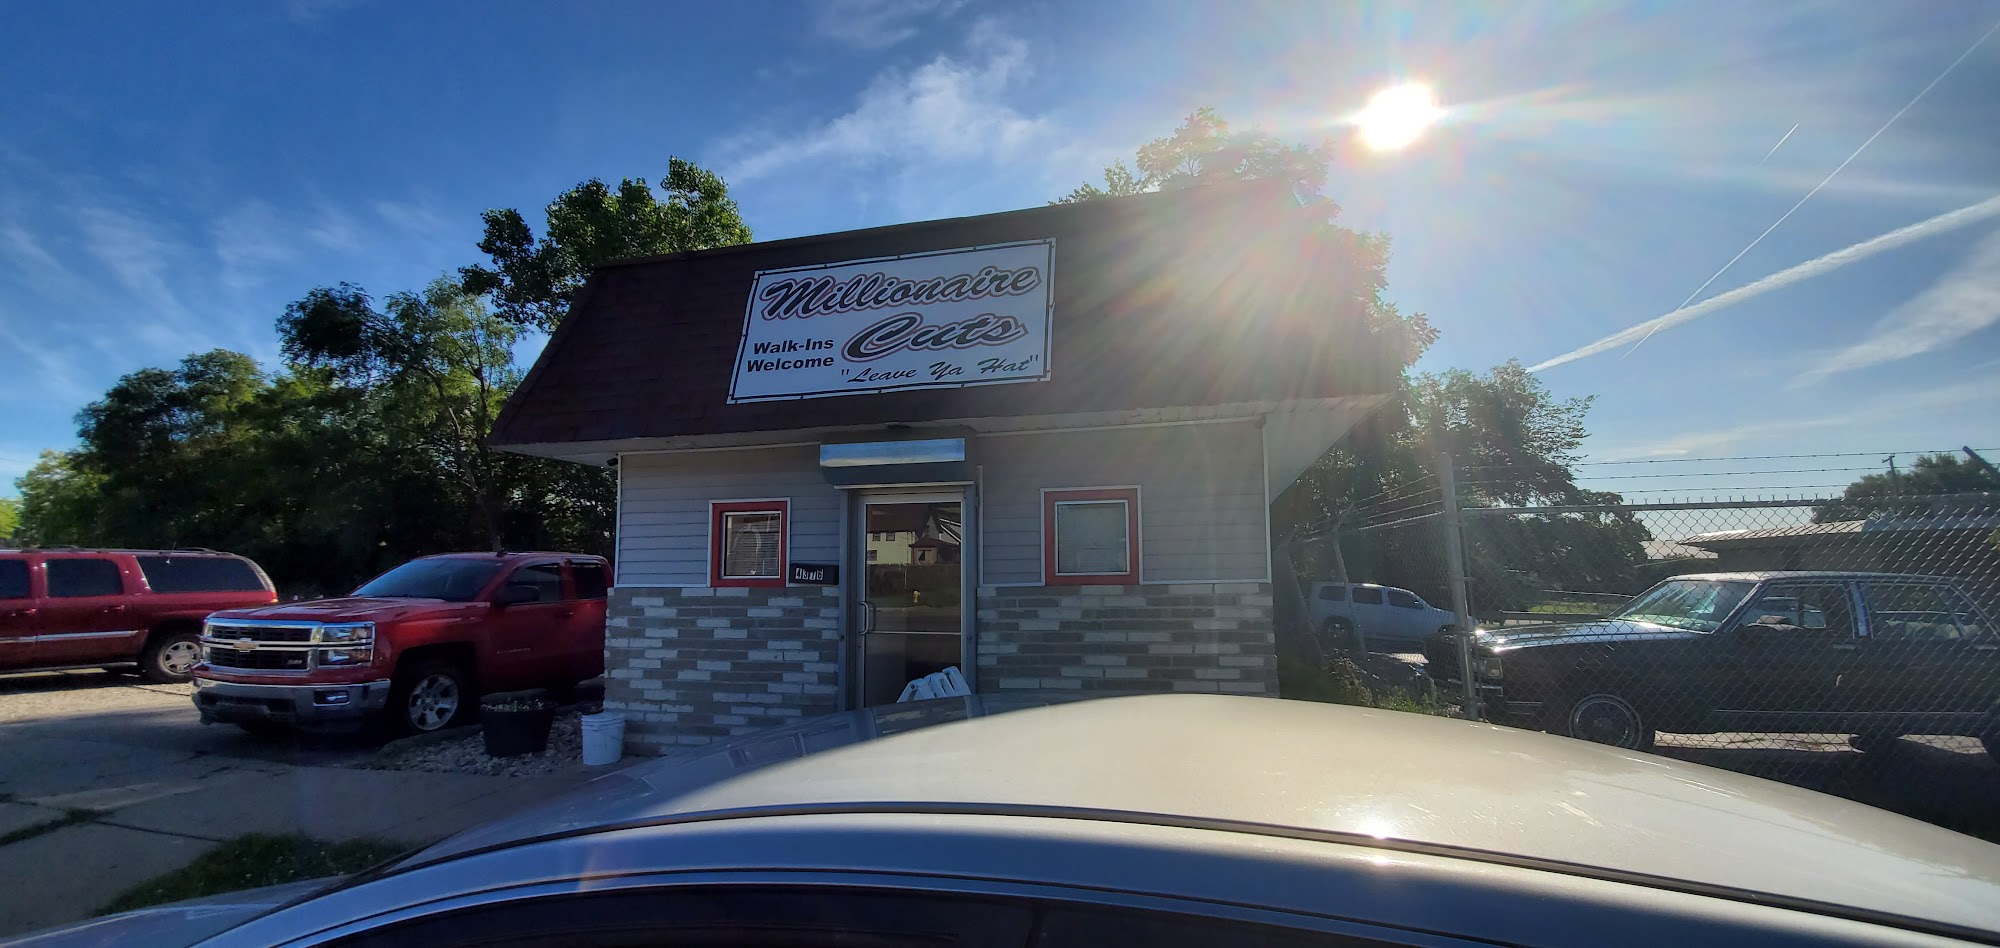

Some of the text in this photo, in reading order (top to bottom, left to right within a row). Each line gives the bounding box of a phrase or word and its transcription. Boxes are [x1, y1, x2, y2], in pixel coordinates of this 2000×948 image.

[760, 265, 1041, 320] Millionaire
[753, 337, 834, 355] Walk-Ins
[841, 312, 1029, 363] Cuts
[747, 355, 834, 372] Welcome
[929, 361, 965, 381] Ya
